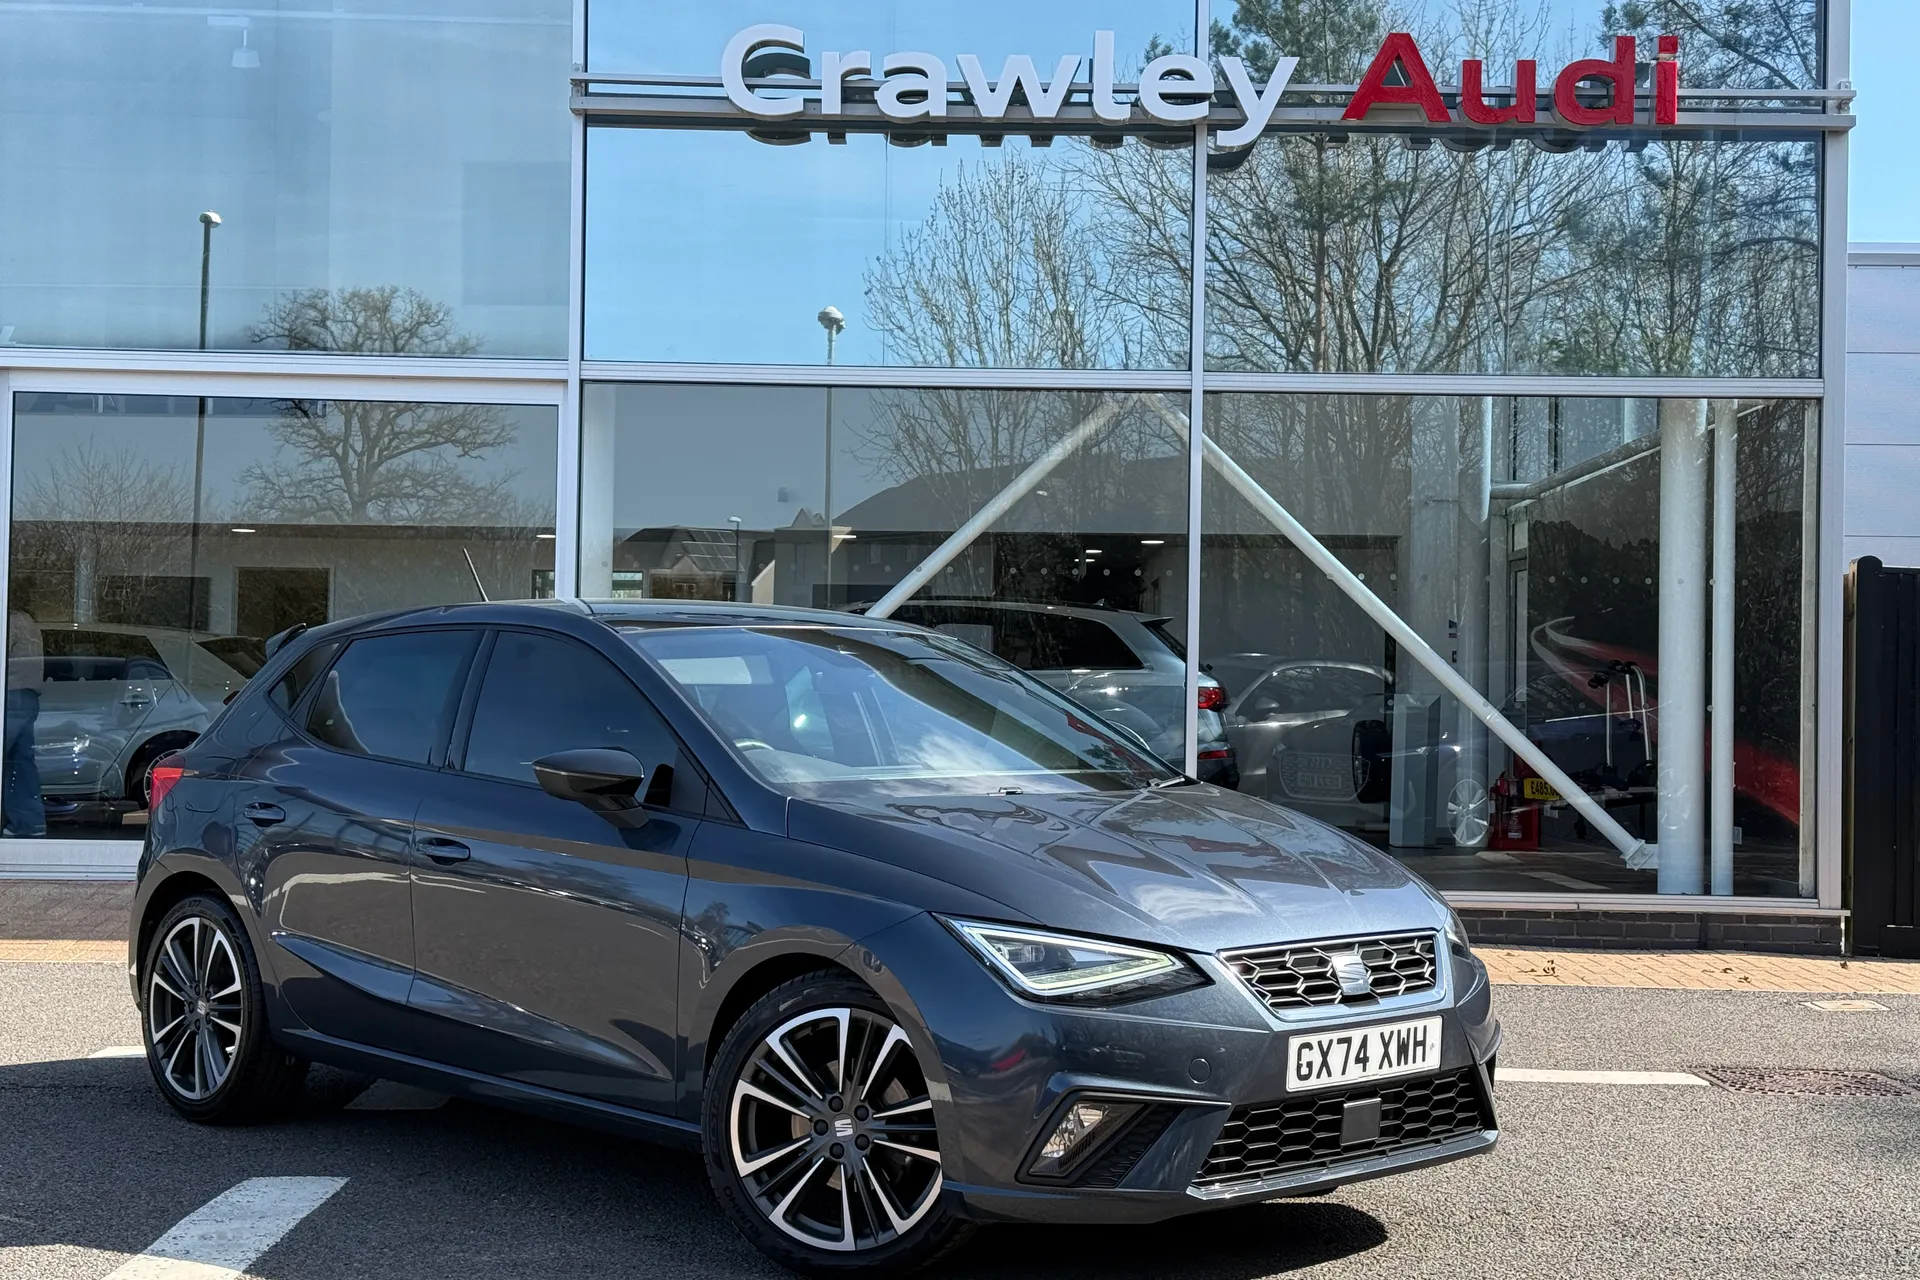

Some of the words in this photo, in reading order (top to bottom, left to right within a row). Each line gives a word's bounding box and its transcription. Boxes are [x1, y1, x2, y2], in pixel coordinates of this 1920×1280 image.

[721, 23, 1299, 149] Crawley
[1343, 32, 1679, 126] Audi
[1296, 1034, 1369, 1081] GX74
[1379, 1025, 1428, 1068] XWH
[722, 1183, 763, 1240] KUMHO
